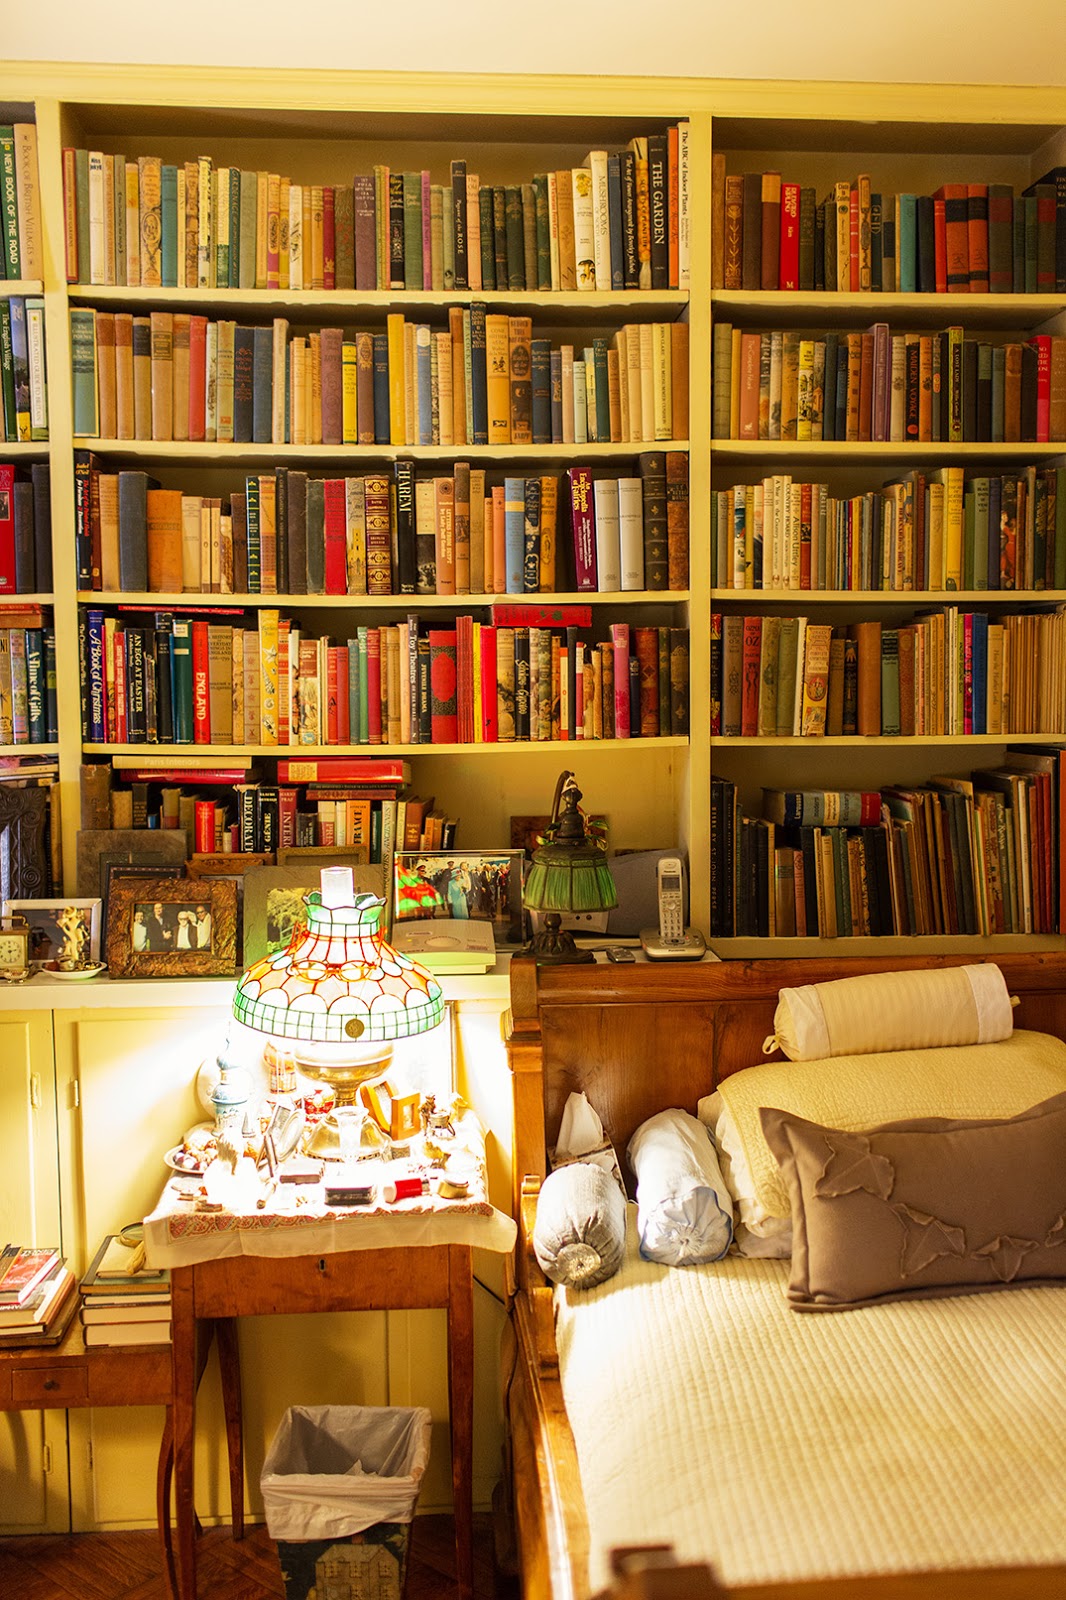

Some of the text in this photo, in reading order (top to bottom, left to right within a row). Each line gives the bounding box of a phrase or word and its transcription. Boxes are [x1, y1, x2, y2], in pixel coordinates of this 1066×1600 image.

[4, 153, 18, 263] NEW BOOK OF THE ROAD
[22, 145, 34, 255] BOOK OF BRITISH VILLAGES
[598, 176, 608, 235] MUSHROOMS
[652, 161, 664, 244] THE GARDEN
[2, 326, 11, 349] English
[32, 323, 40, 364] ILLUSTRATED
[3, 349, 11, 370] Village
[34, 387, 41, 395] TO
[909, 350, 918, 419] MAIDEN VOYAGE
[399, 470, 411, 512] HAREM
[579, 473, 588, 512] Encyclopedia
[586, 482, 591, 490] An
[791, 542, 799, 566] Uttley
[409, 635, 418, 684] Toy Theatres
[746, 636, 760, 646] OZ
[29, 658, 41, 685] Time
[29, 686, 42, 696] of
[89, 629, 103, 724] A Book of Christmas
[134, 634, 143, 712] AN EGG AT EASTER
[29, 696, 42, 722] Gifts
[196, 672, 206, 720] ENGLAND
[145, 759, 164, 767] Paris
[244, 796, 253, 853] DECORATI
[794, 794, 802, 820] Larousse
[354, 811, 362, 844] FRANCE
